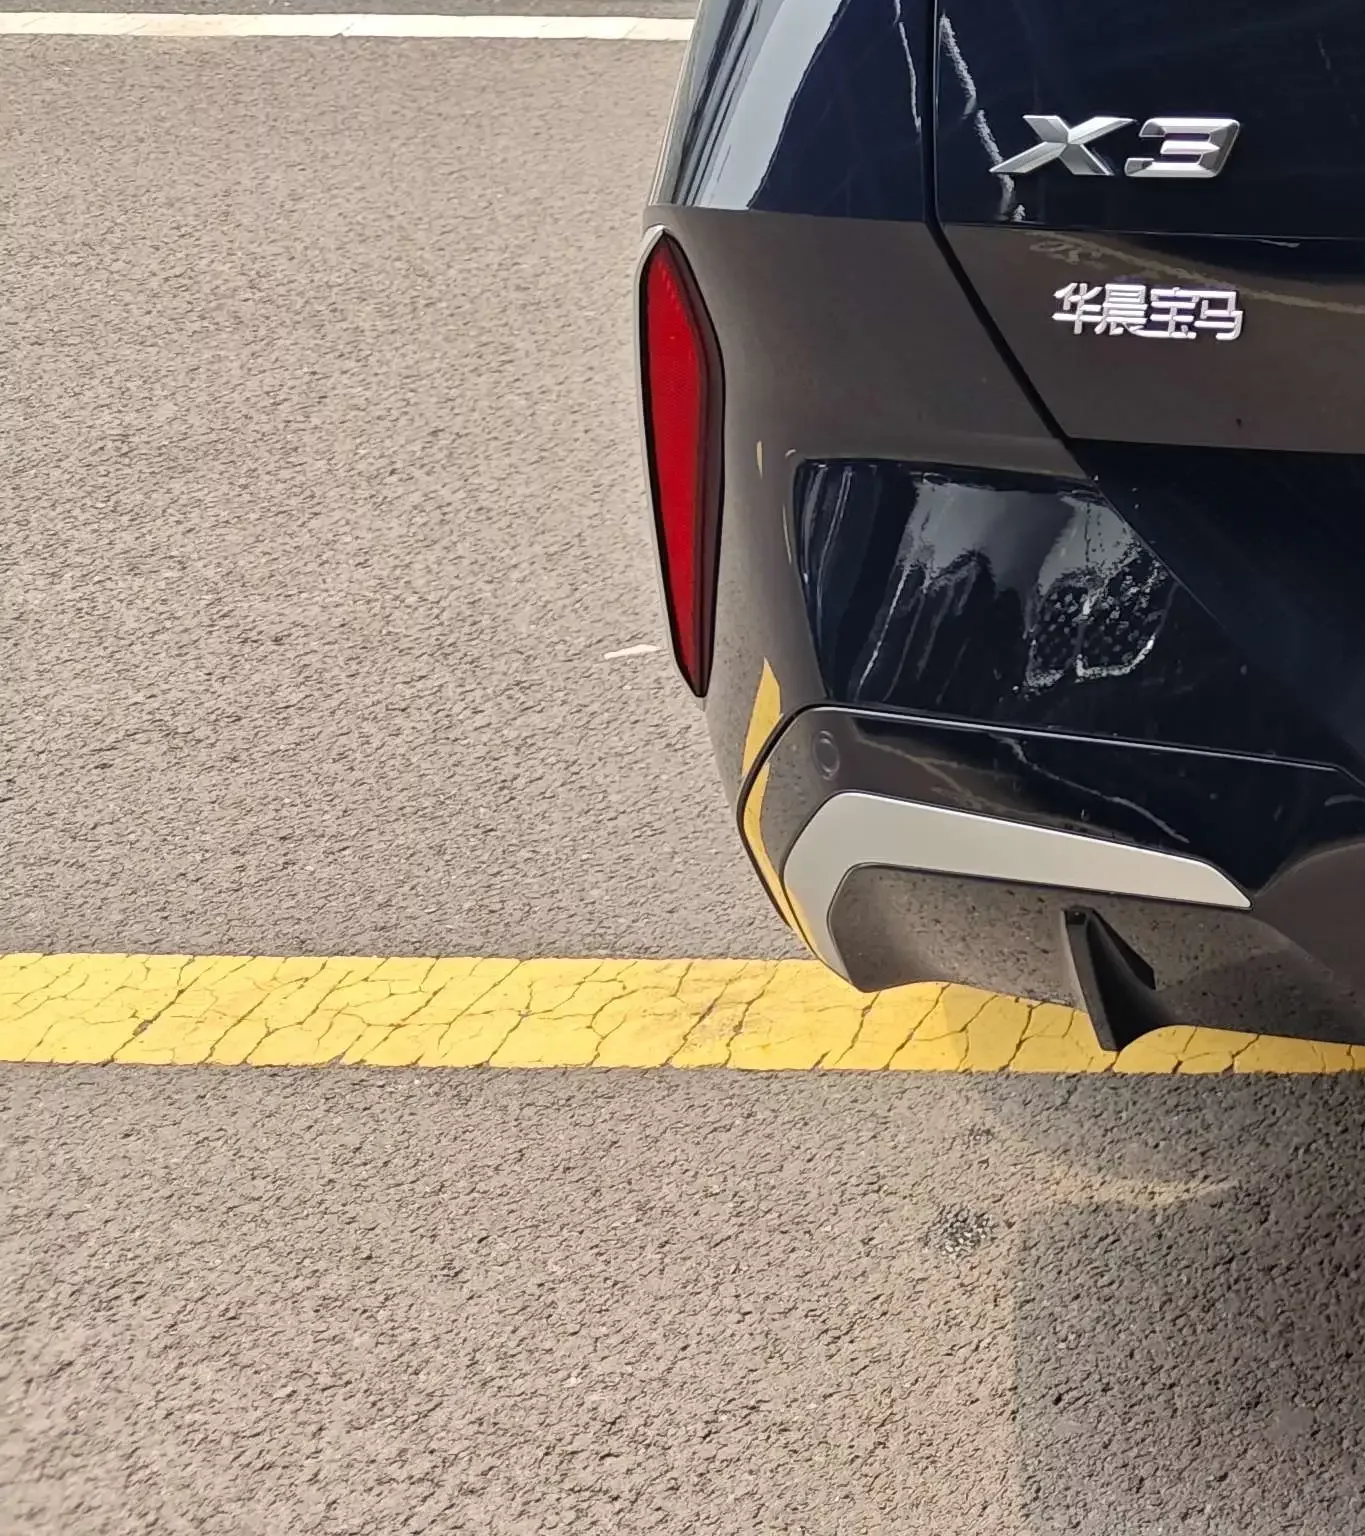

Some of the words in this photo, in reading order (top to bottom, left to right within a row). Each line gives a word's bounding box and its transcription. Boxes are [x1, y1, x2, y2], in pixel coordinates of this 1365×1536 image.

[989, 115, 1241, 178] X3
[1052, 282, 1244, 340] 华晨宝马
